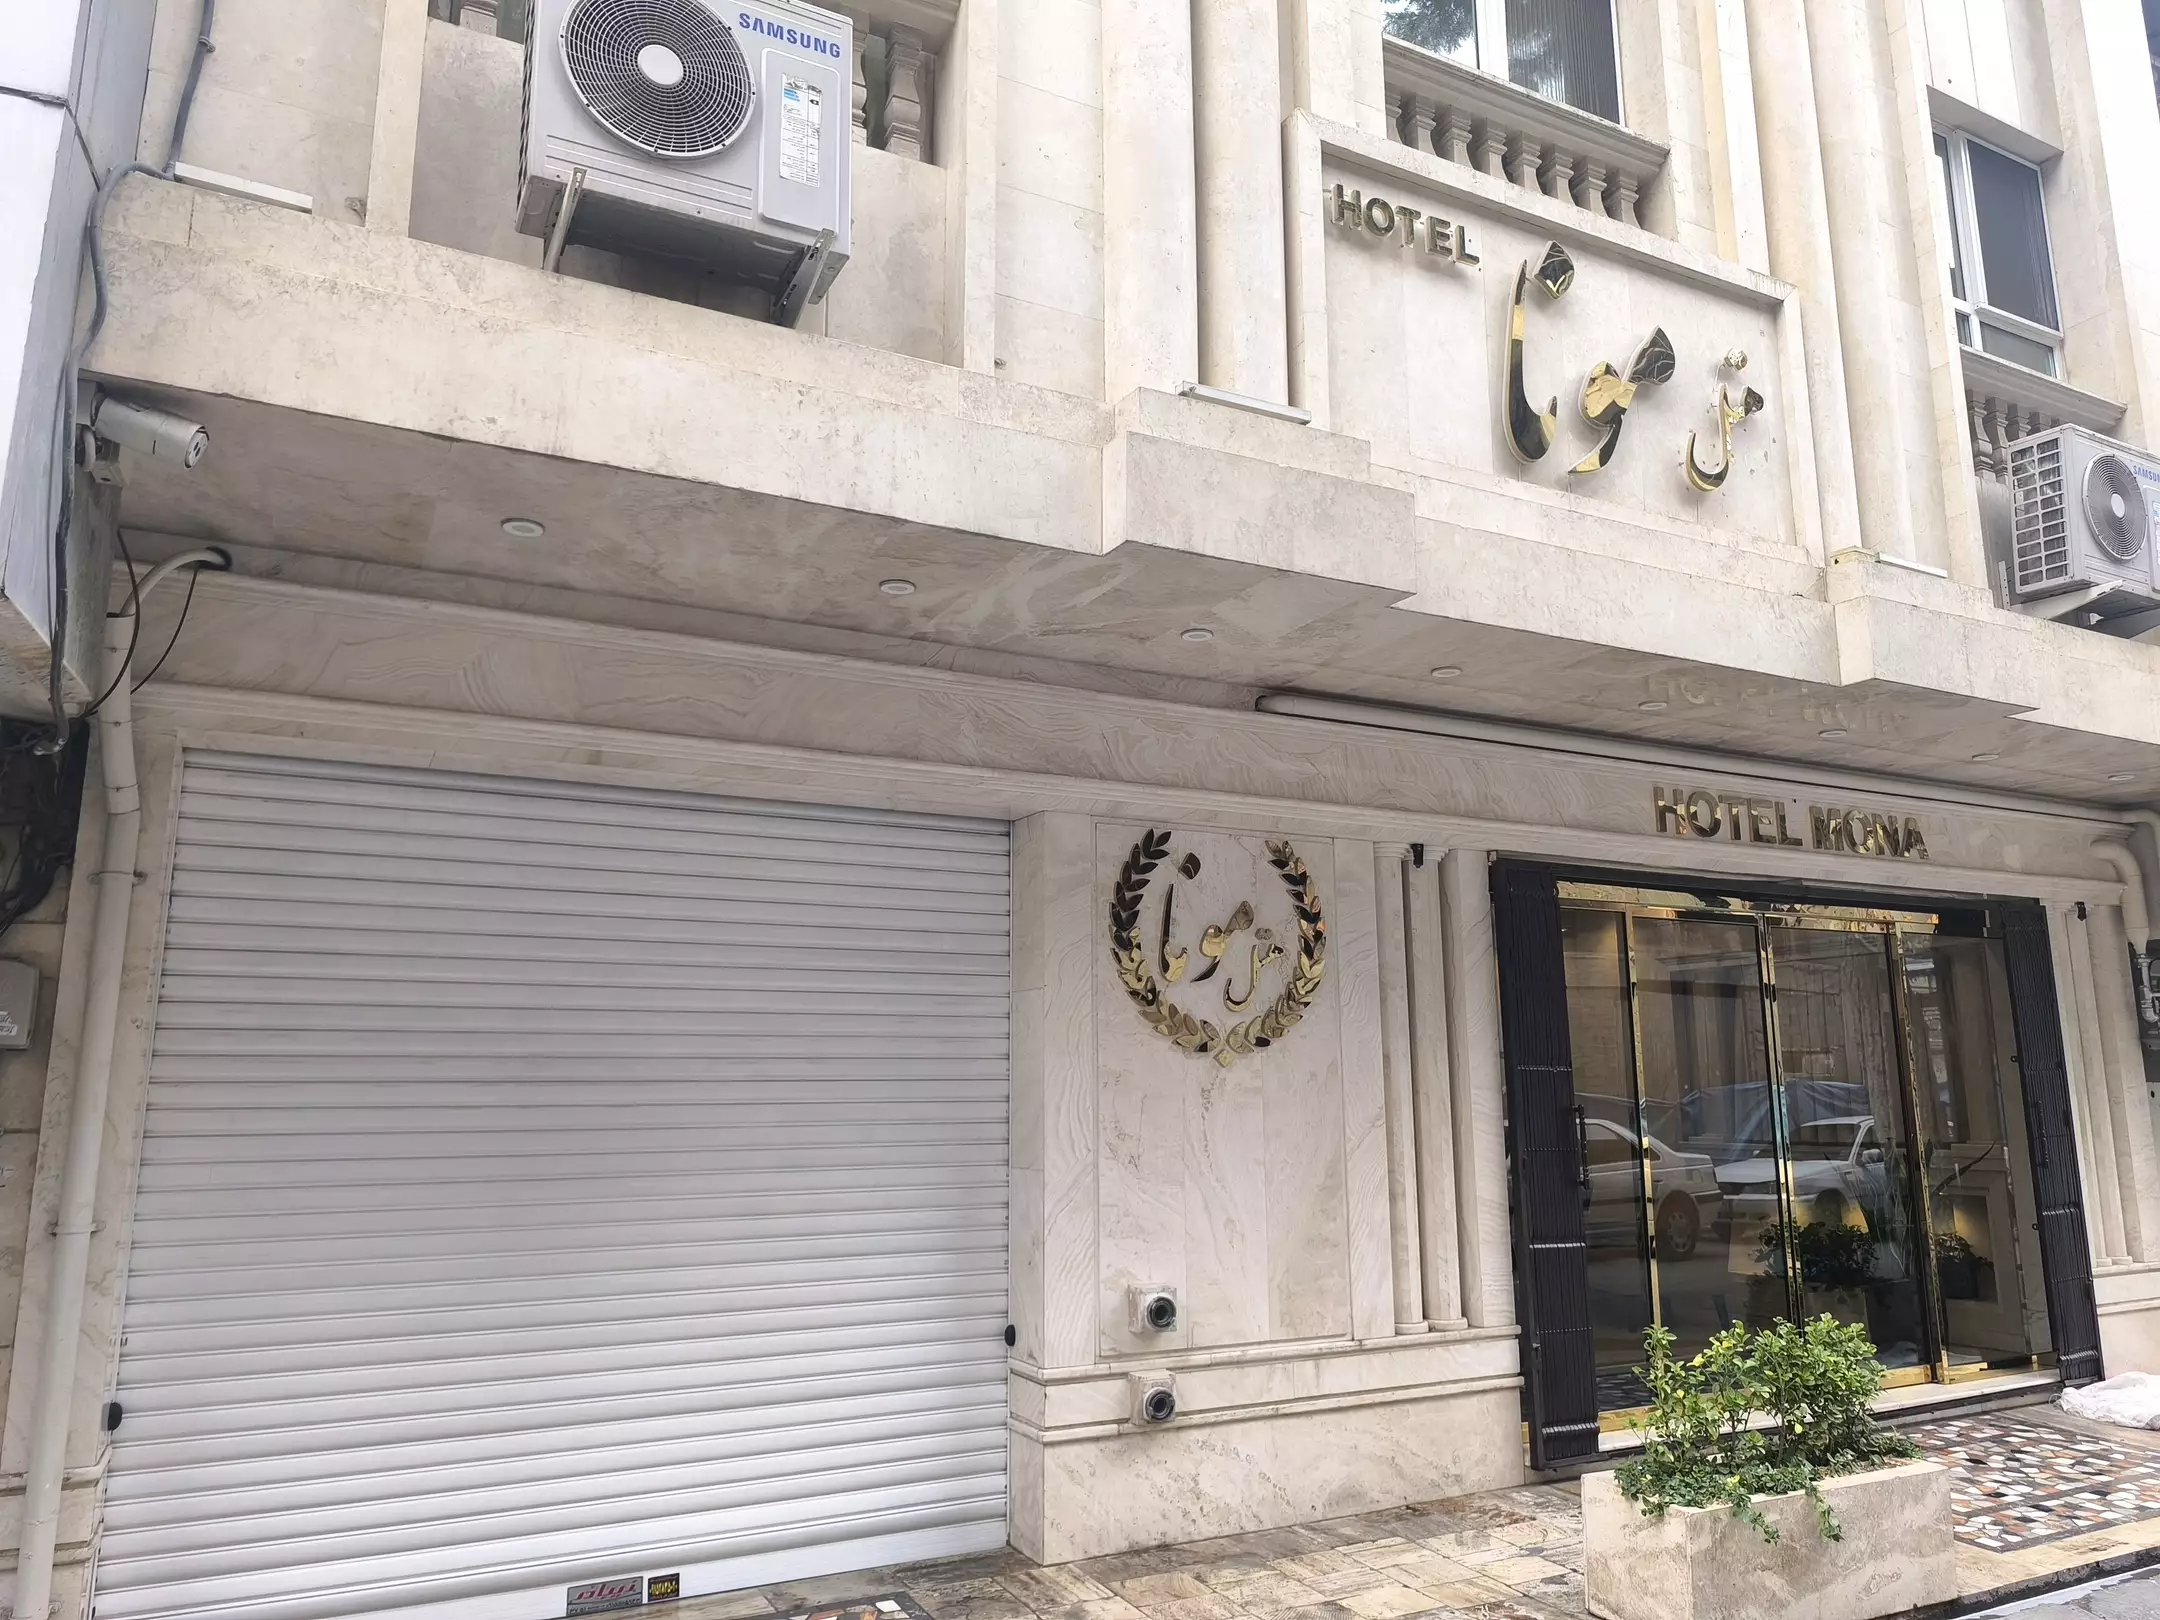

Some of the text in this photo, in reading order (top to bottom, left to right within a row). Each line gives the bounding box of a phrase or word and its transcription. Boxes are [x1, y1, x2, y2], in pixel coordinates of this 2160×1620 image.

[738, 12, 841, 59] SAMSUNG
[1330, 183, 1480, 267] HOTEL
[1653, 785, 1930, 860] HOTEL MONA
